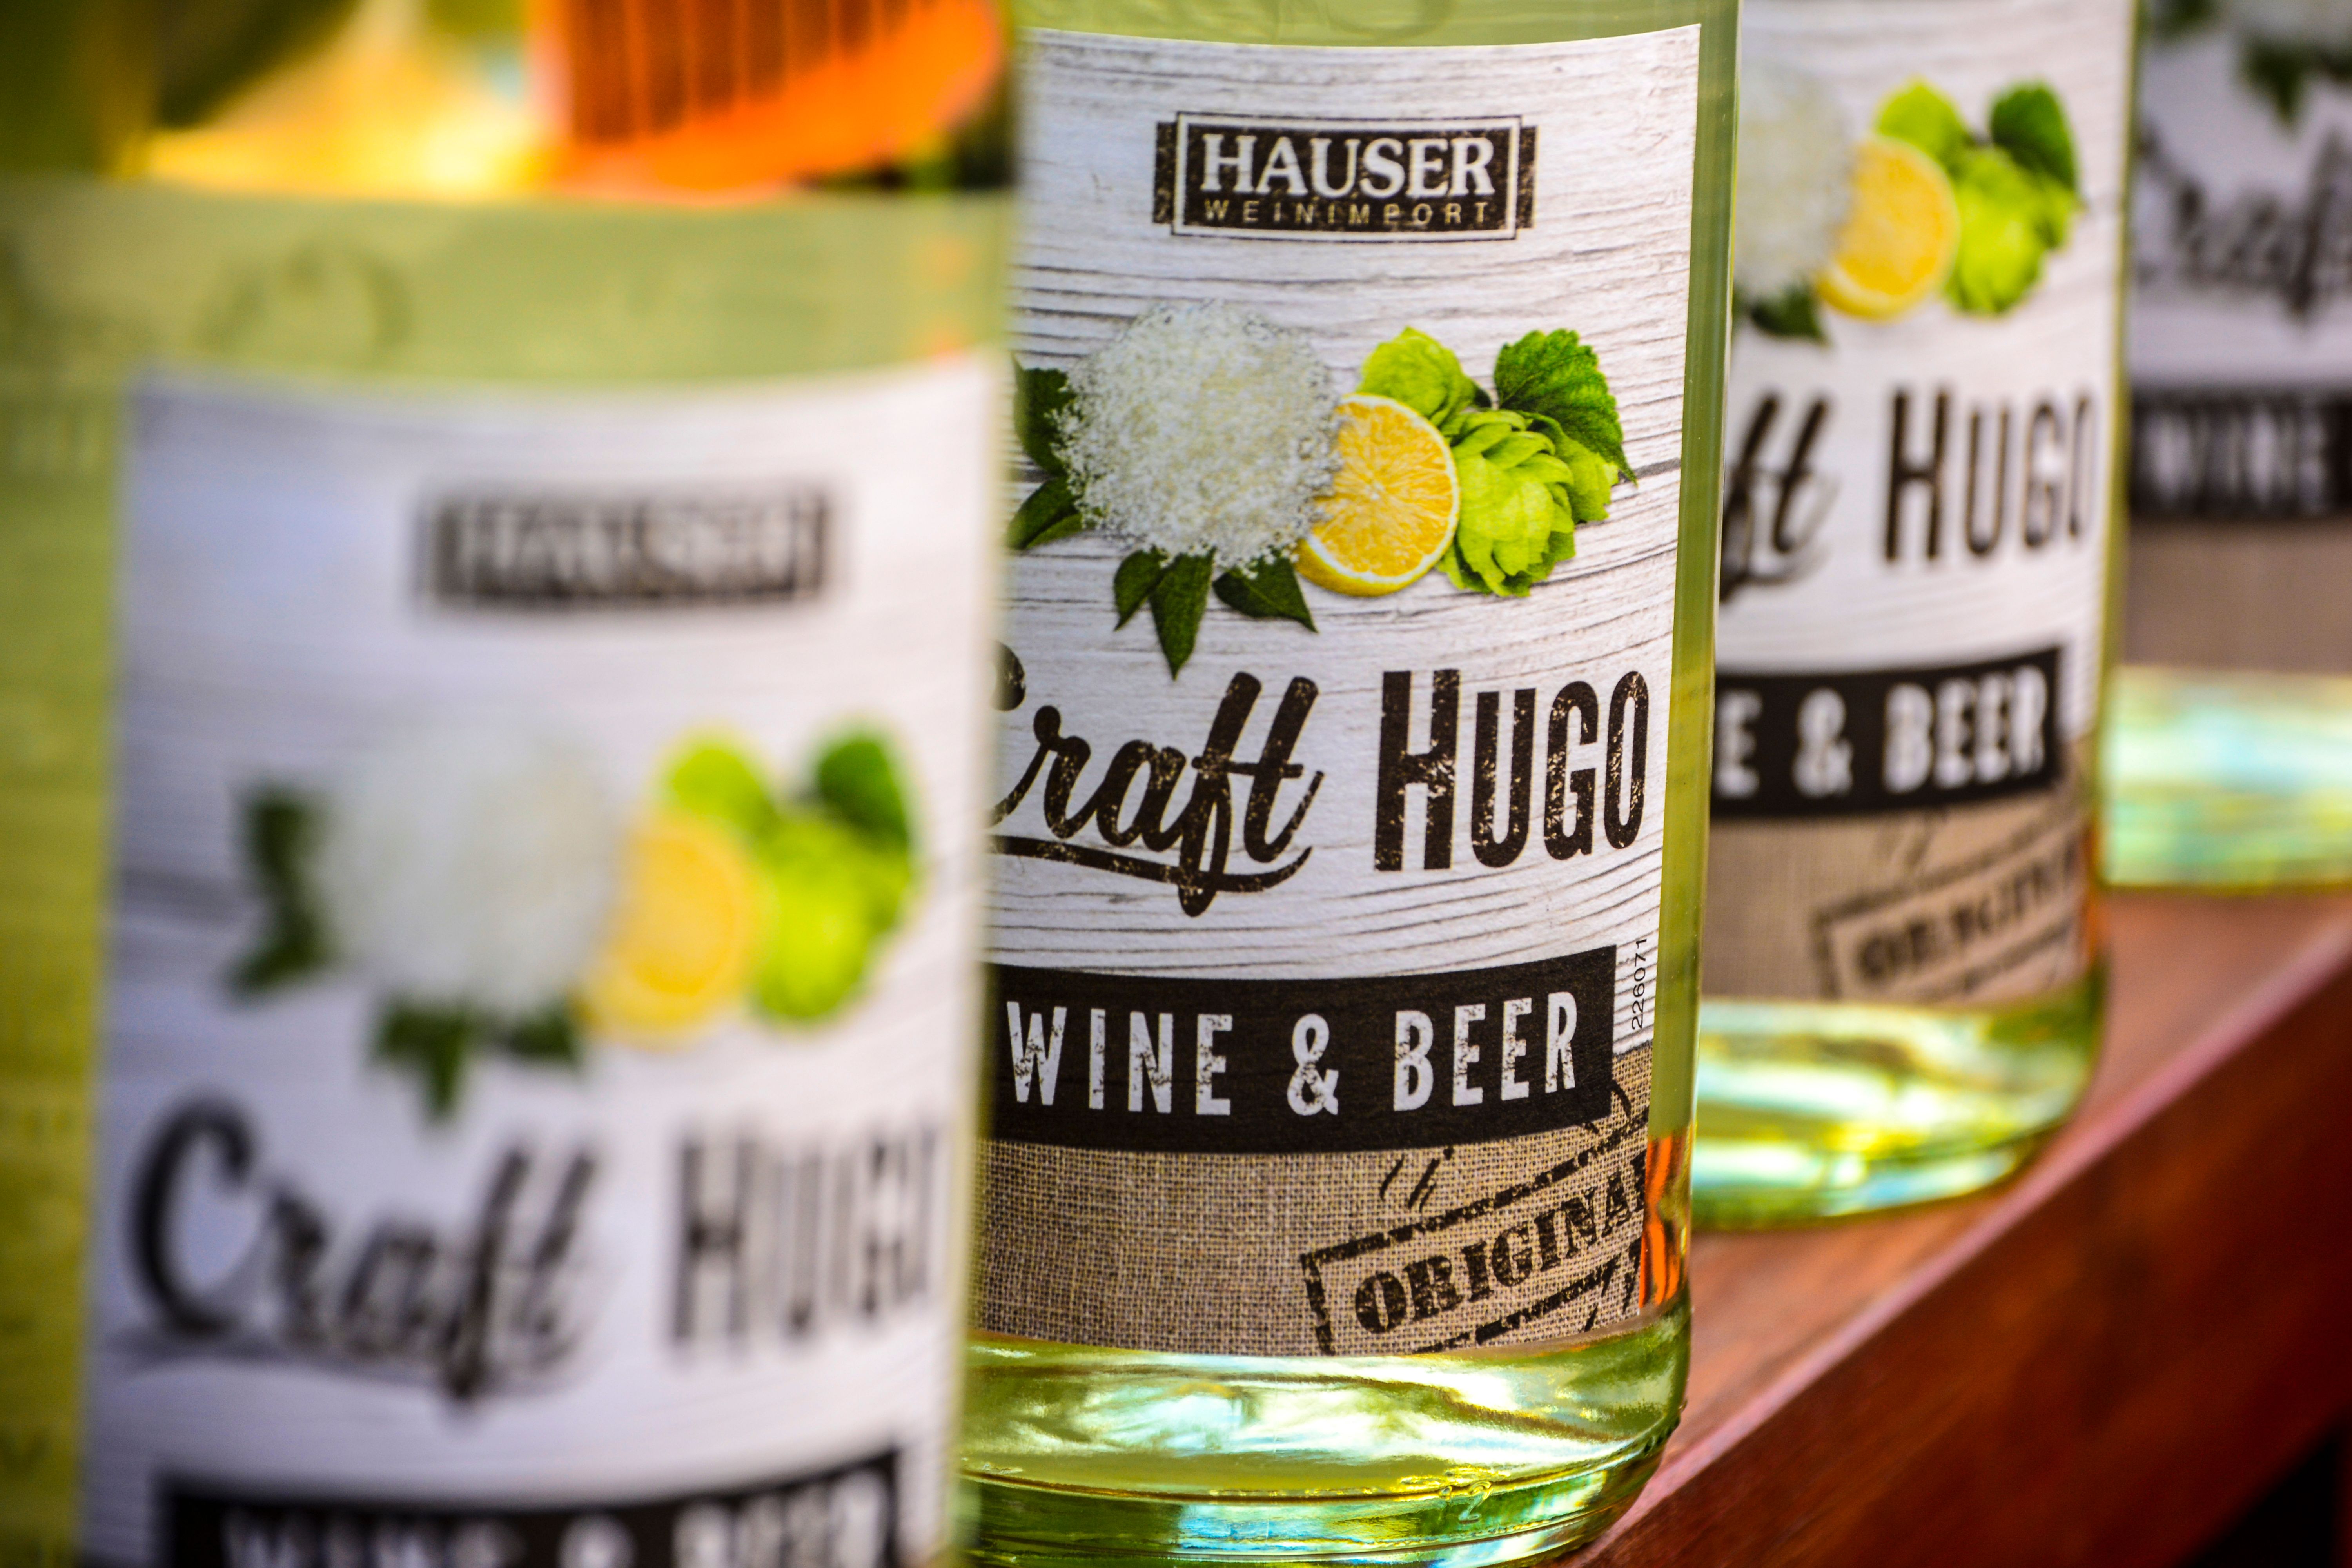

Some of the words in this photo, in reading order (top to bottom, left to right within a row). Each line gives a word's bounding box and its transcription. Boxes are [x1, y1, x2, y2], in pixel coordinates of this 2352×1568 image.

[1201, 133, 1495, 199] HAUSER
[1205, 199, 1488, 227] WEINIMPORT
[1374, 668, 1650, 872] HUGO
[1631, 938, 1647, 1030] 226071
[1006, 1000, 1233, 1116] WINE
[1287, 1013, 1339, 1117] &
[1393, 992, 1578, 1112] BEER
